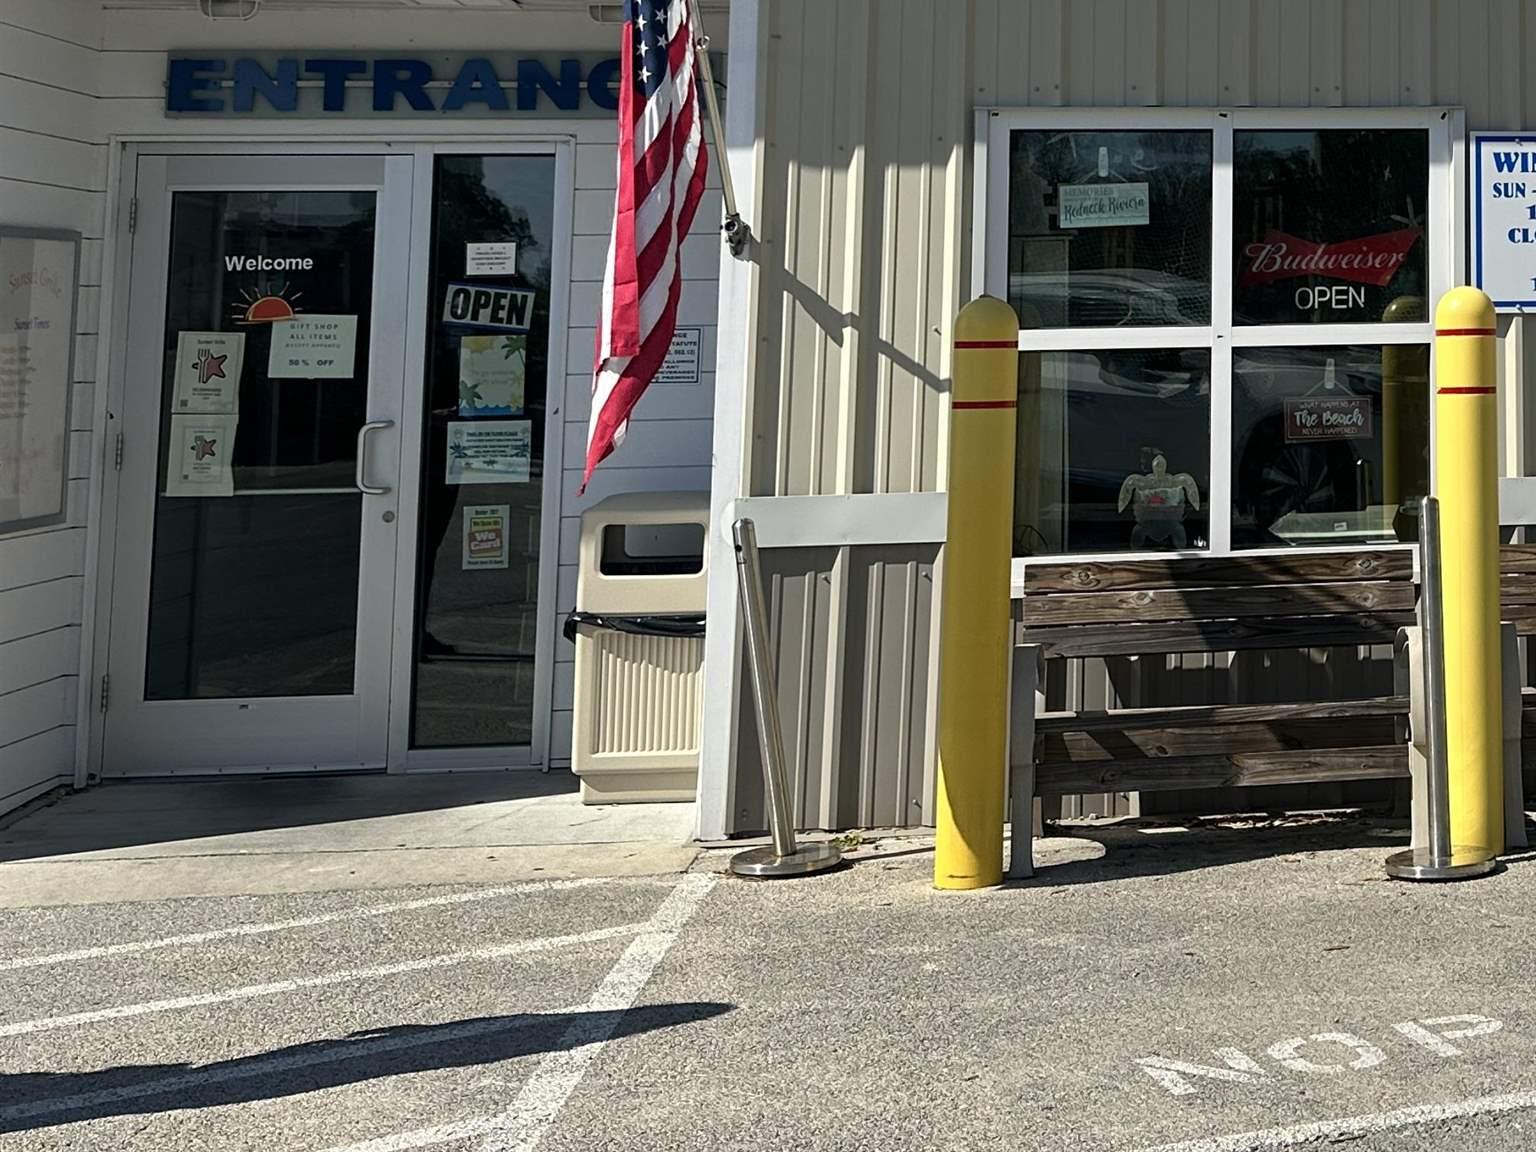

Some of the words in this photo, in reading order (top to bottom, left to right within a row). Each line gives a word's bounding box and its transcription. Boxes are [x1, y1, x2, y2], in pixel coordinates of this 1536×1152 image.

[1492, 183, 1526, 198] SUN
[225, 255, 313, 272] Welcome
[1246, 241, 1404, 273] Budweiser
[450, 288, 529, 326] OPEN
[1295, 286, 1365, 309] OPEN
[1294, 409, 1319, 427] The
[1322, 408, 1365, 426] Beach
[1137, 1031, 1383, 1097] NO
